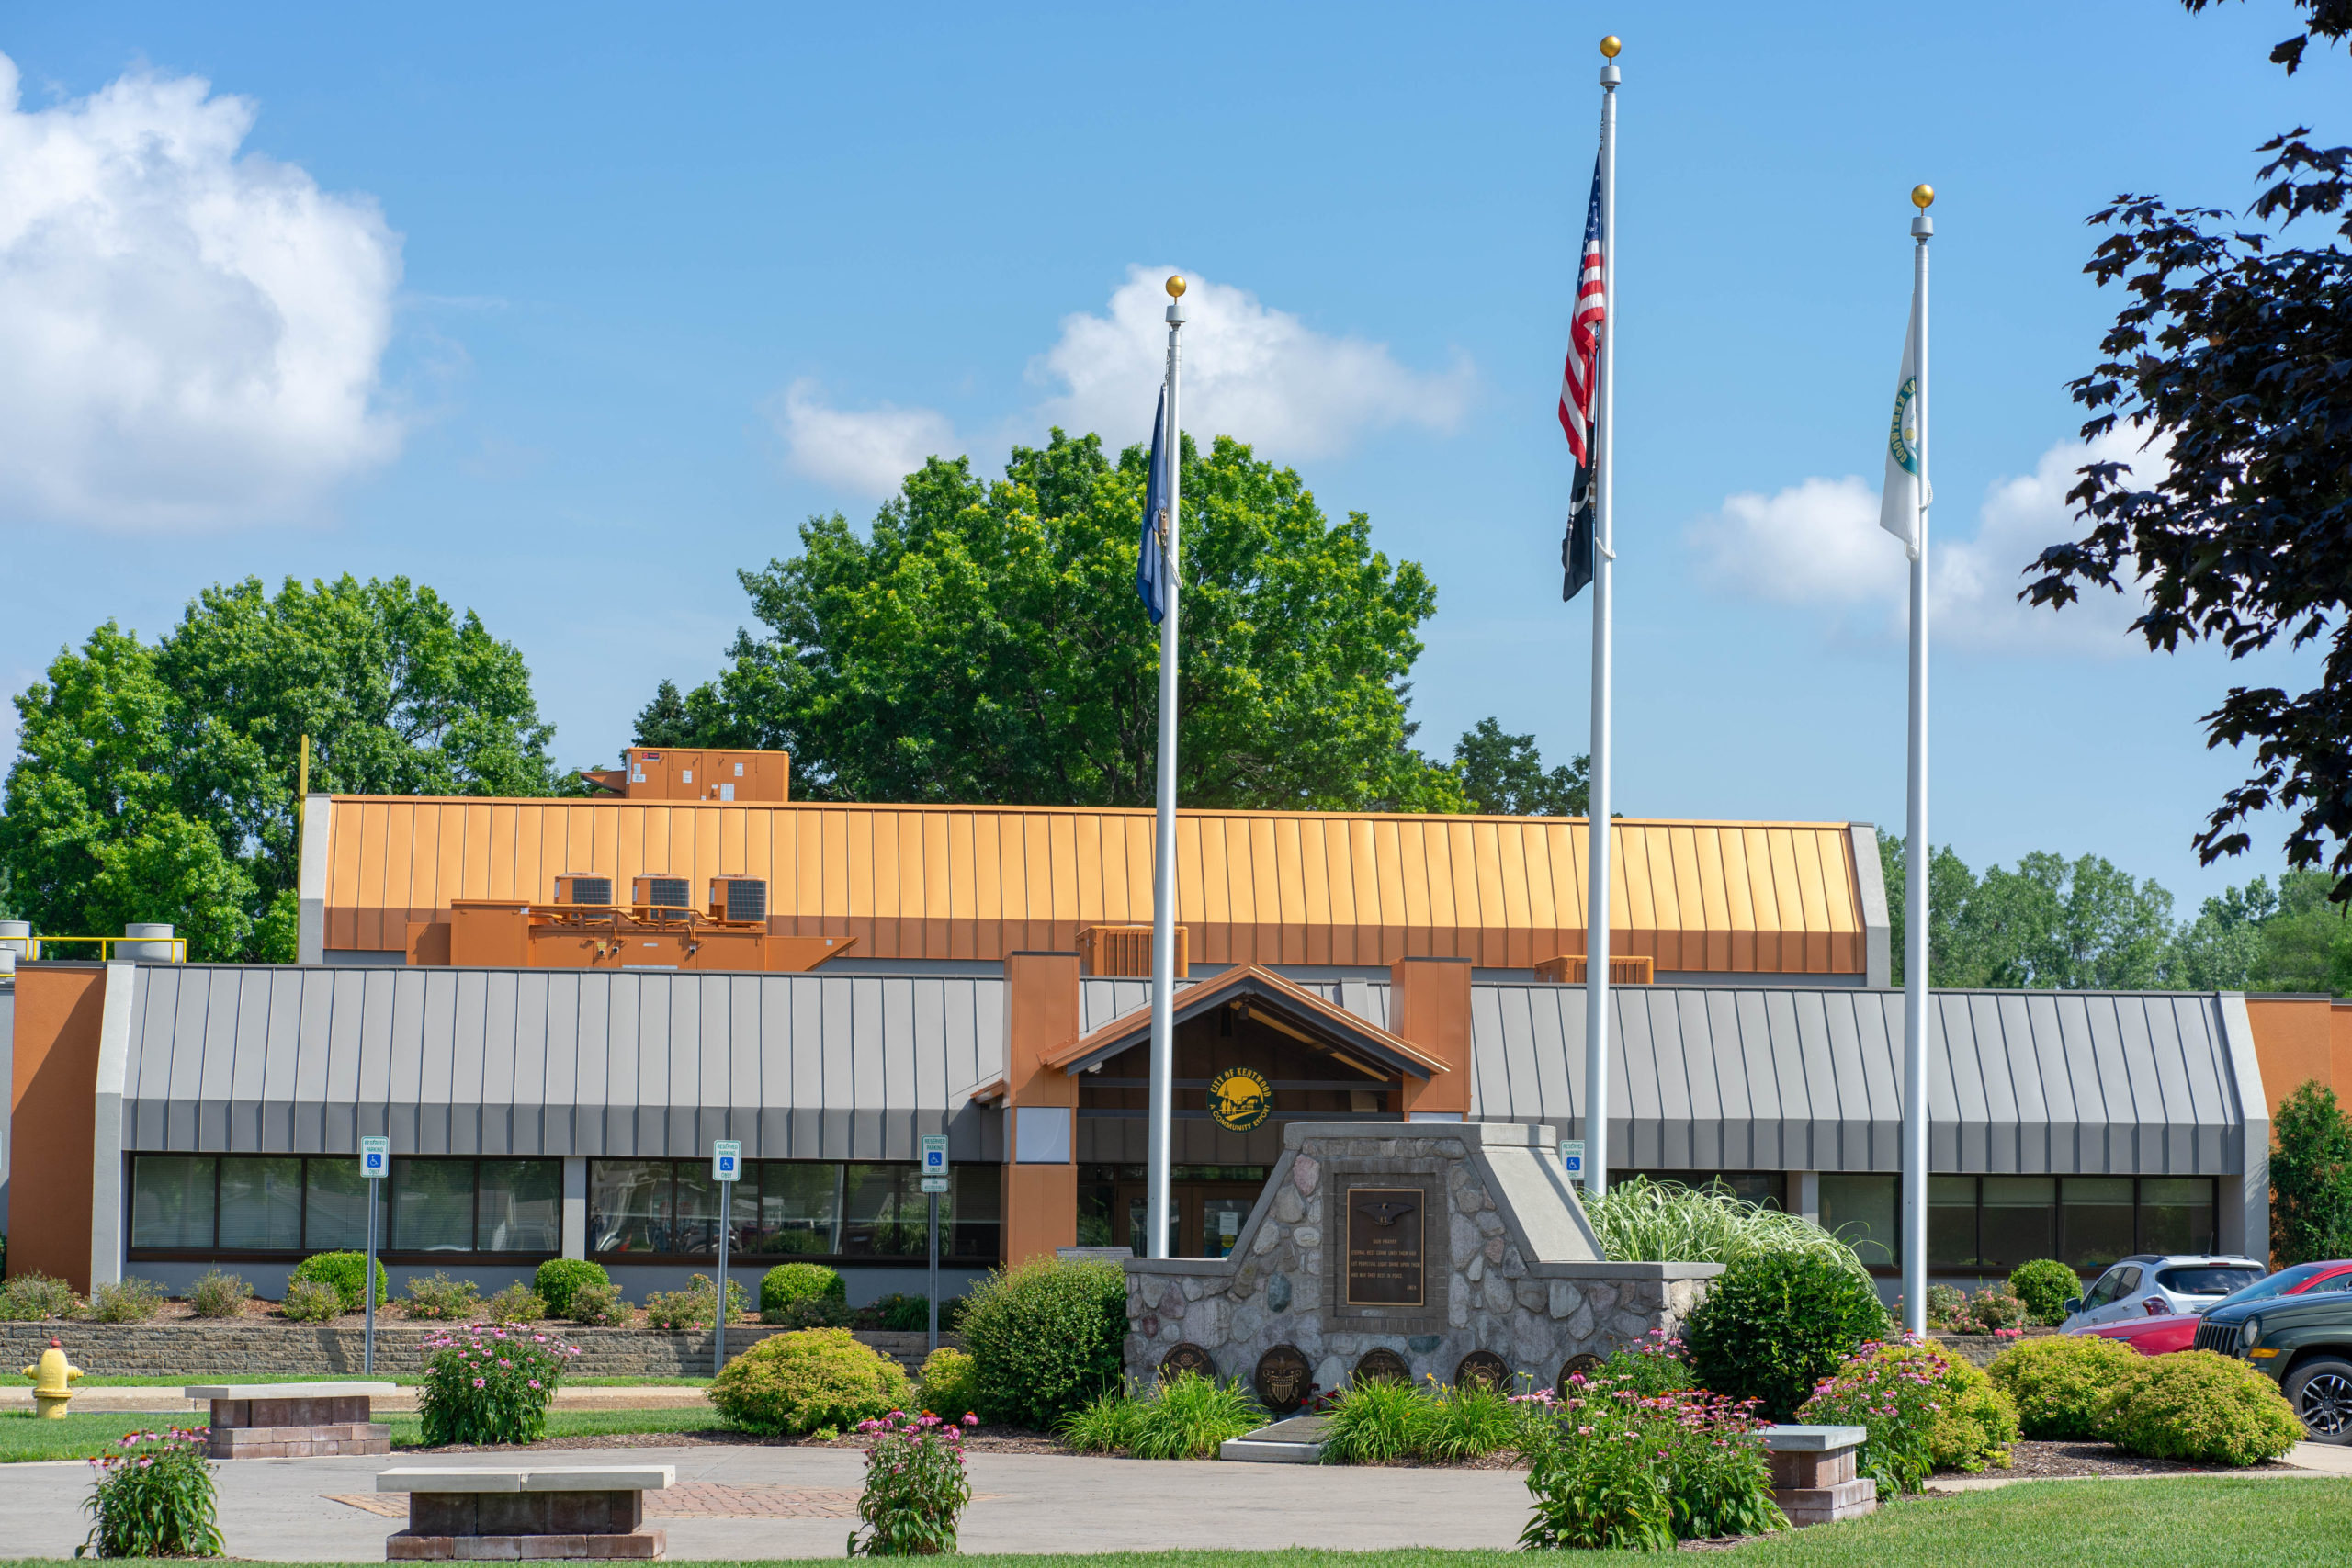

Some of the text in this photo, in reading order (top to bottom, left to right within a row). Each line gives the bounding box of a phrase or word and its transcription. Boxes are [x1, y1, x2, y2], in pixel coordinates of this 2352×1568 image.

[1210, 1067, 1272, 1097] CITY OF KENTWOOD
[1213, 1111, 1252, 1132] COMMUNITY
[1252, 1104, 1272, 1127] EFFORT
